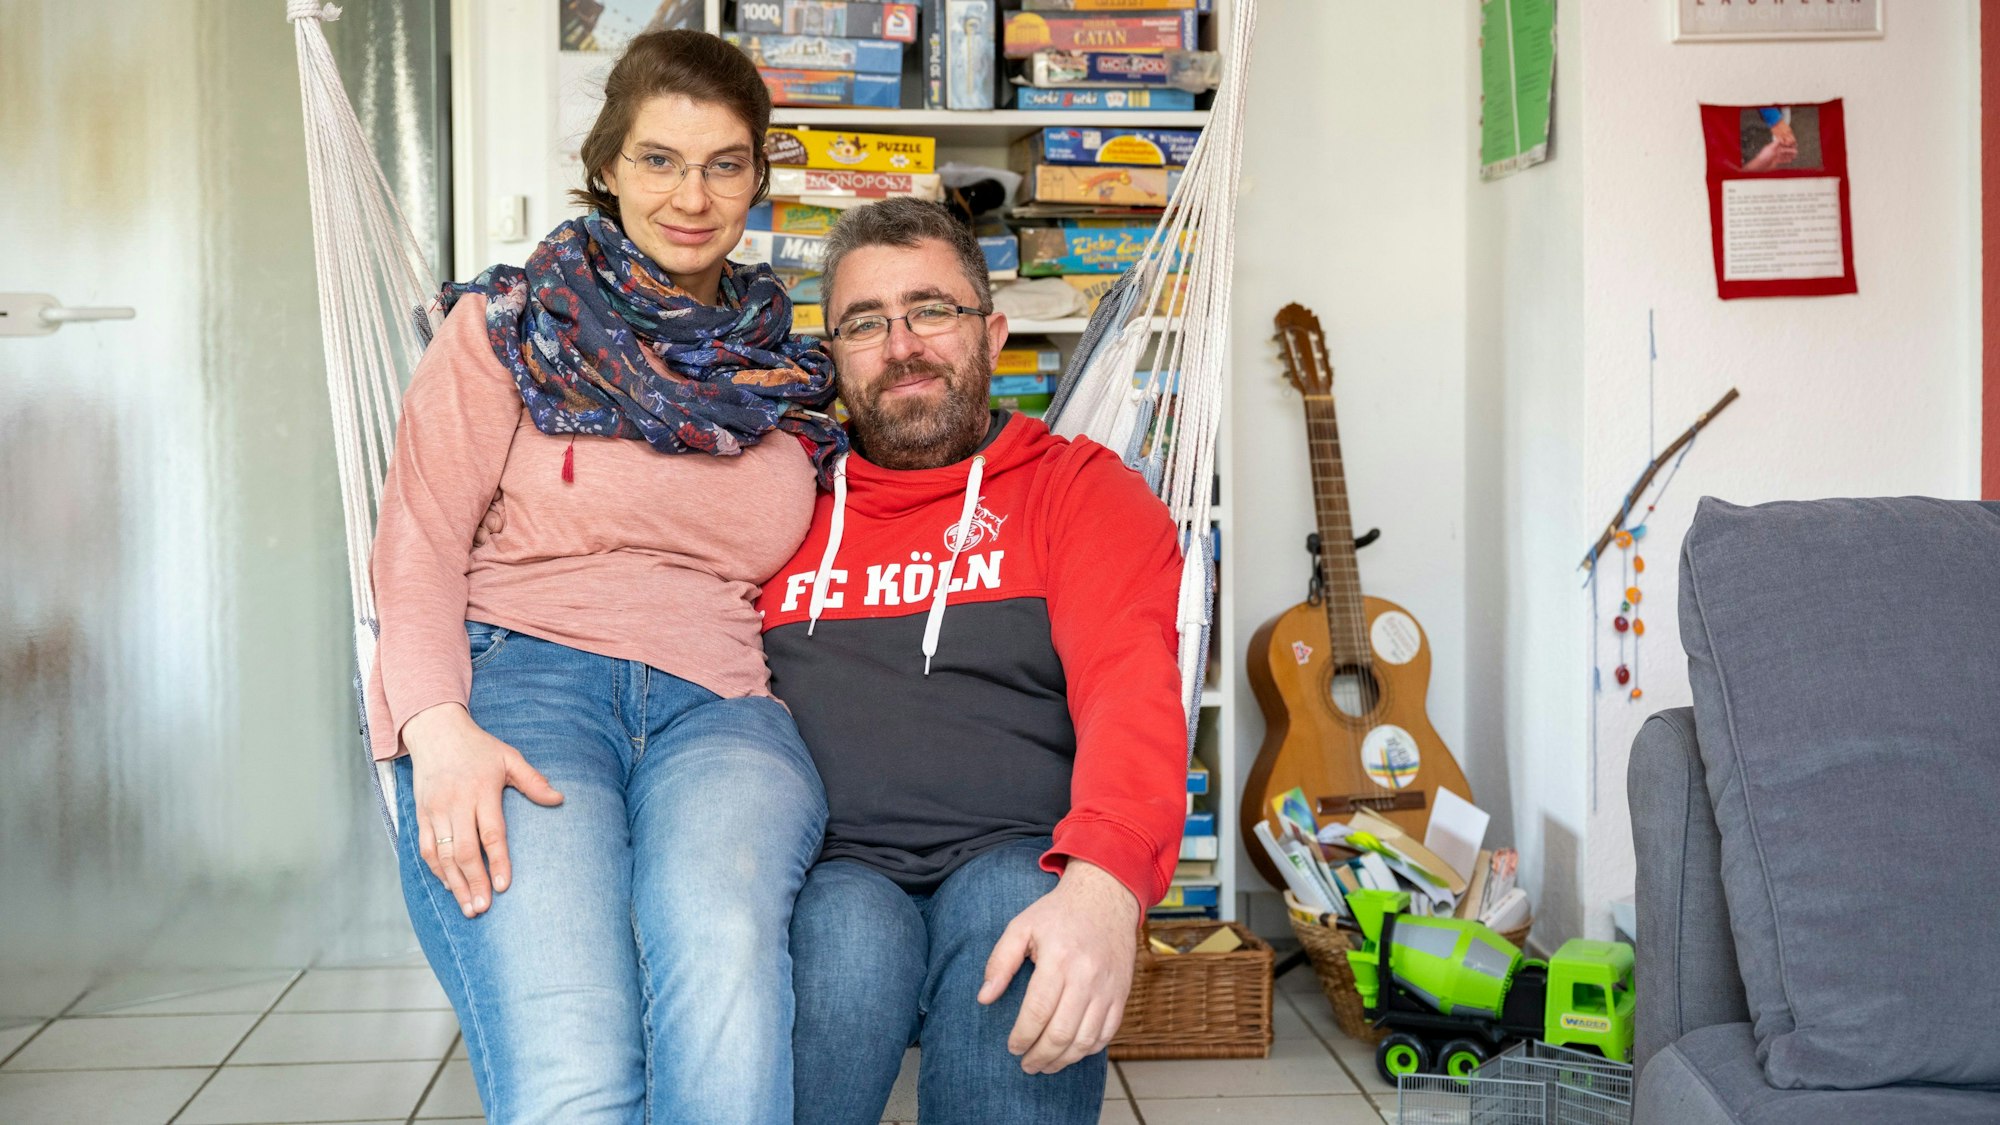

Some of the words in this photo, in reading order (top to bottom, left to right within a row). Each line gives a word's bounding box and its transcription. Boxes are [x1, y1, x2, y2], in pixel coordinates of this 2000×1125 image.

[742, 4, 780, 20] 1000
[1073, 30, 1127, 46] CATAN
[876, 141, 922, 154] PUZZLE
[810, 174, 907, 190] MONOPOLY
[780, 569, 849, 612] FC
[863, 550, 1005, 606] KÖLN
